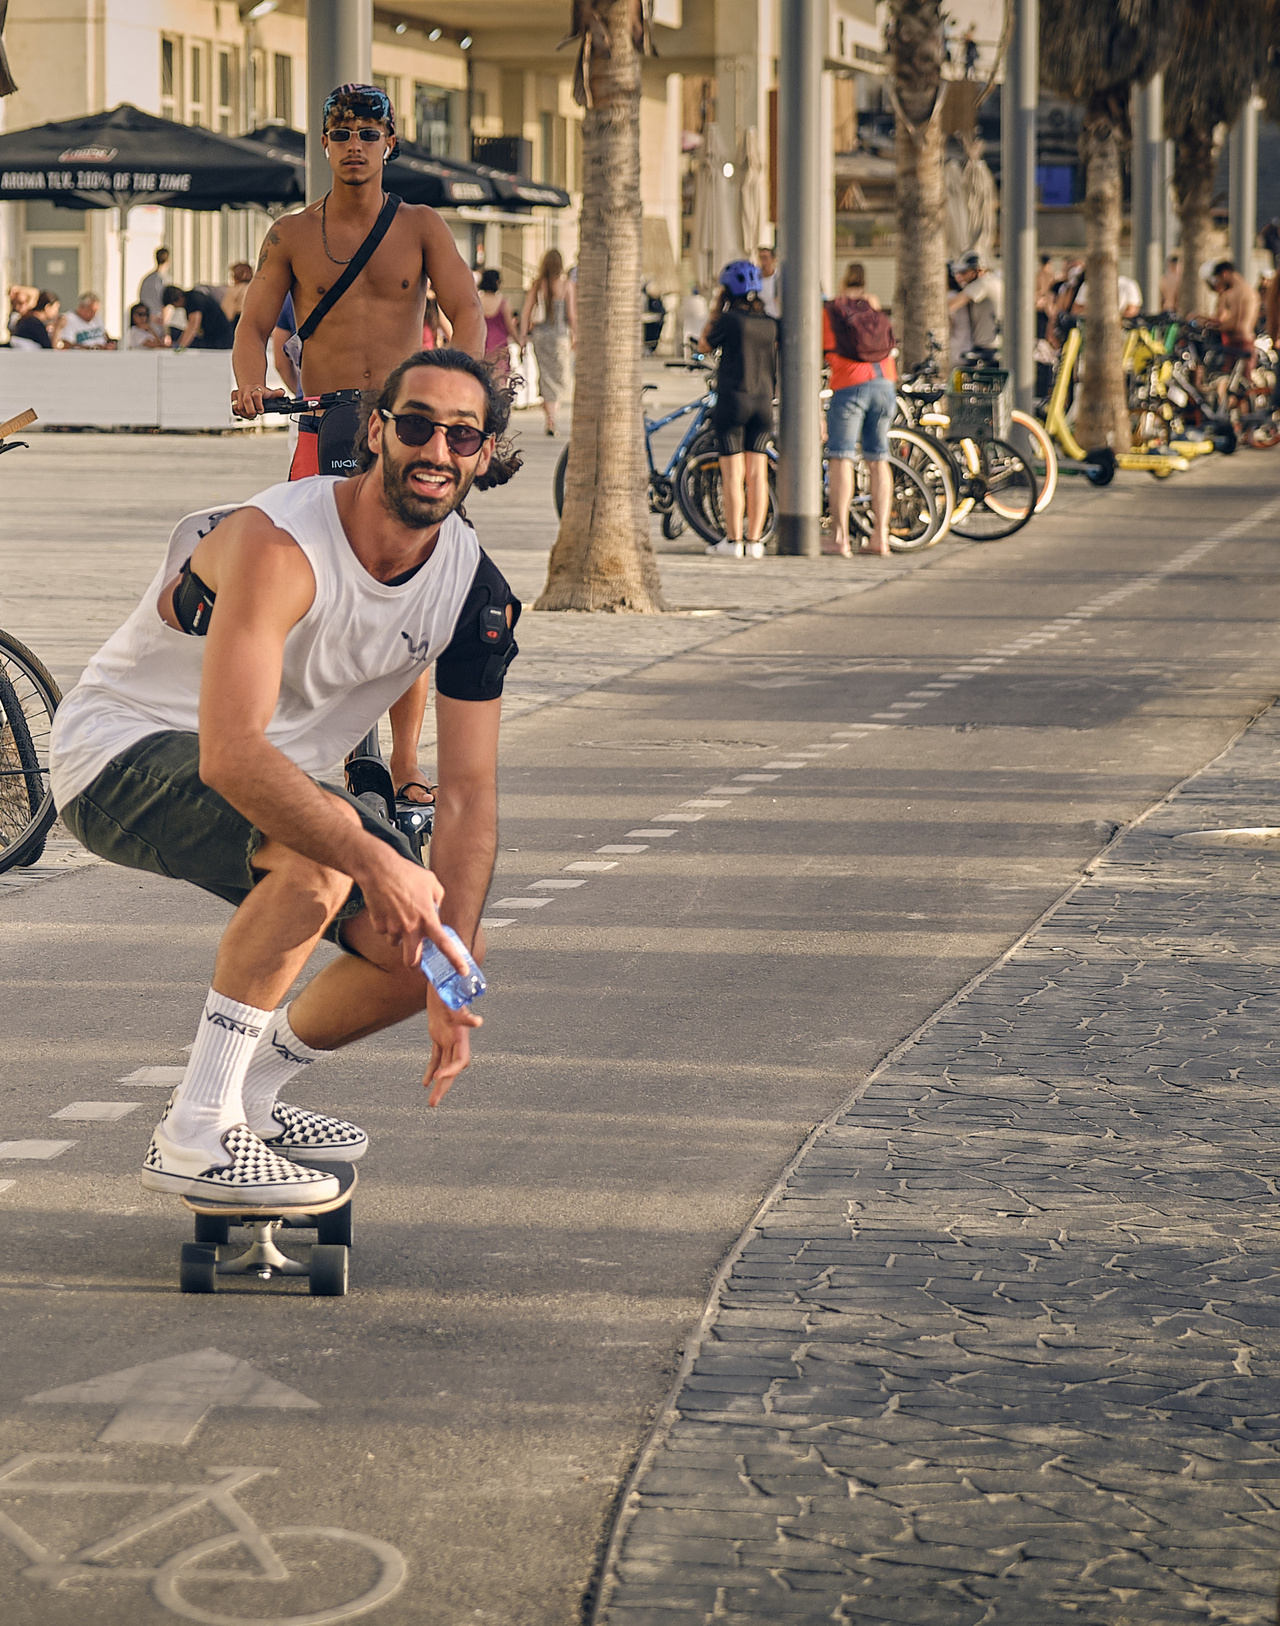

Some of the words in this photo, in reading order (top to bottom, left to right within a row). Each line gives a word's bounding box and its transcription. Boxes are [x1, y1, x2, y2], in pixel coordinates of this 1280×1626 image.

[1, 172, 46, 190] AROMA
[77, 171, 112, 189] 100%
[113, 172, 131, 190] OF
[133, 173, 157, 190] THE
[159, 173, 192, 191] TIME
[331, 459, 358, 469] INOK
[205, 1005, 262, 1038] VANS
